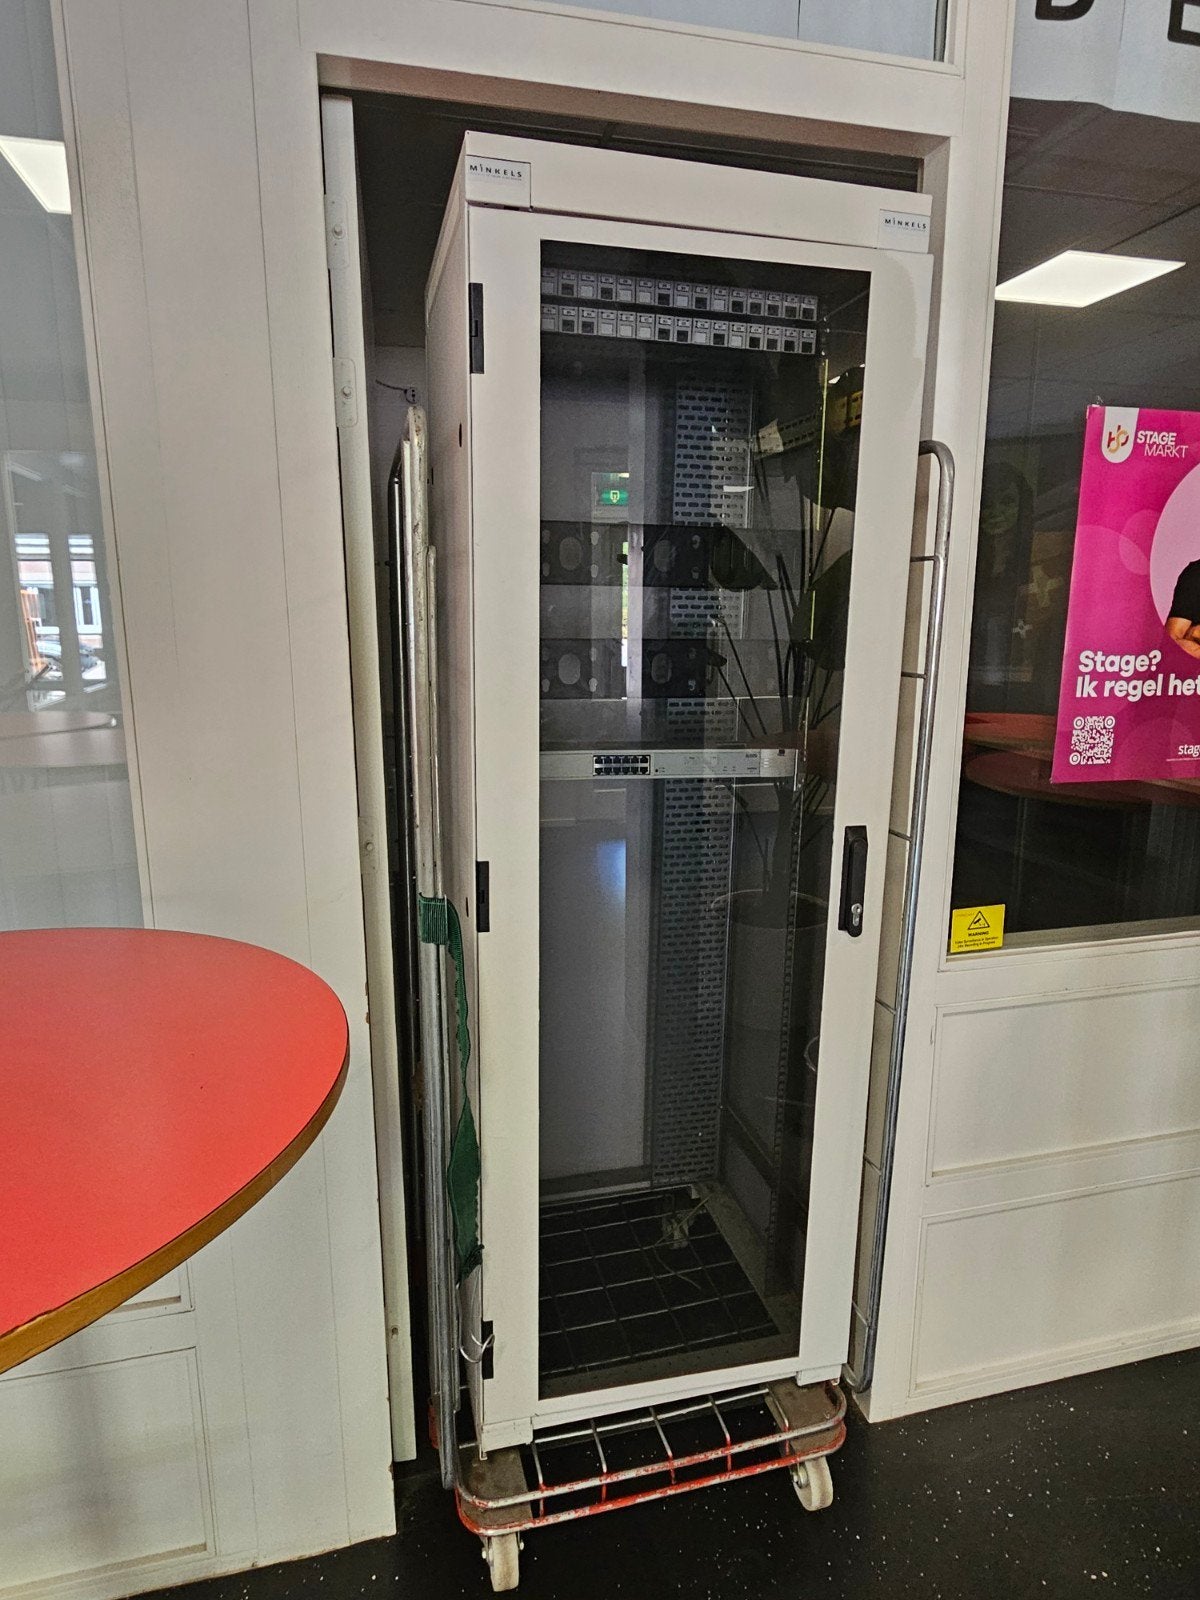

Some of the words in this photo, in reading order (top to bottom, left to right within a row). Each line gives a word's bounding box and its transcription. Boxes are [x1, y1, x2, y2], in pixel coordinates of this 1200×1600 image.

[1137, 430, 1177, 445] STAGE
[1144, 443, 1189, 459] MARKT
[1078, 649, 1162, 678] Stage?
[1075, 674, 1098, 698] Ik
[1103, 673, 1164, 703] regel
[1178, 743, 1200, 757] stag
